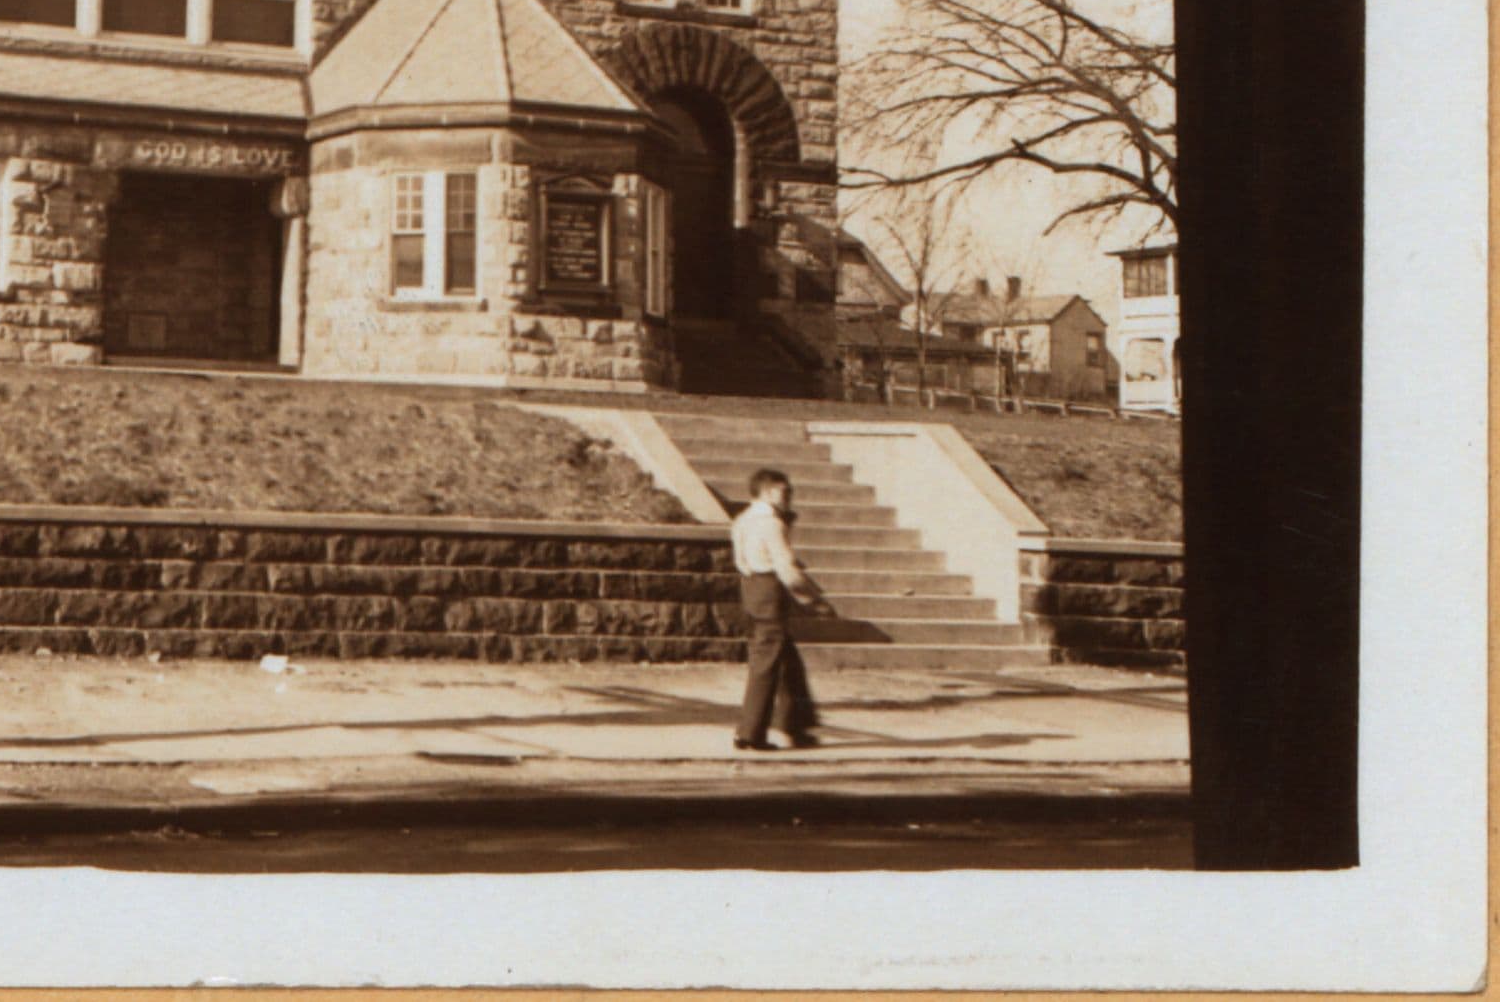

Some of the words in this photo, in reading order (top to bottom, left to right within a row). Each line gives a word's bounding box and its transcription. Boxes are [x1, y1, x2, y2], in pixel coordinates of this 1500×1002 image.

[135, 141, 187, 160] GOD
[199, 144, 222, 164] IS
[231, 145, 293, 166] LOVE
